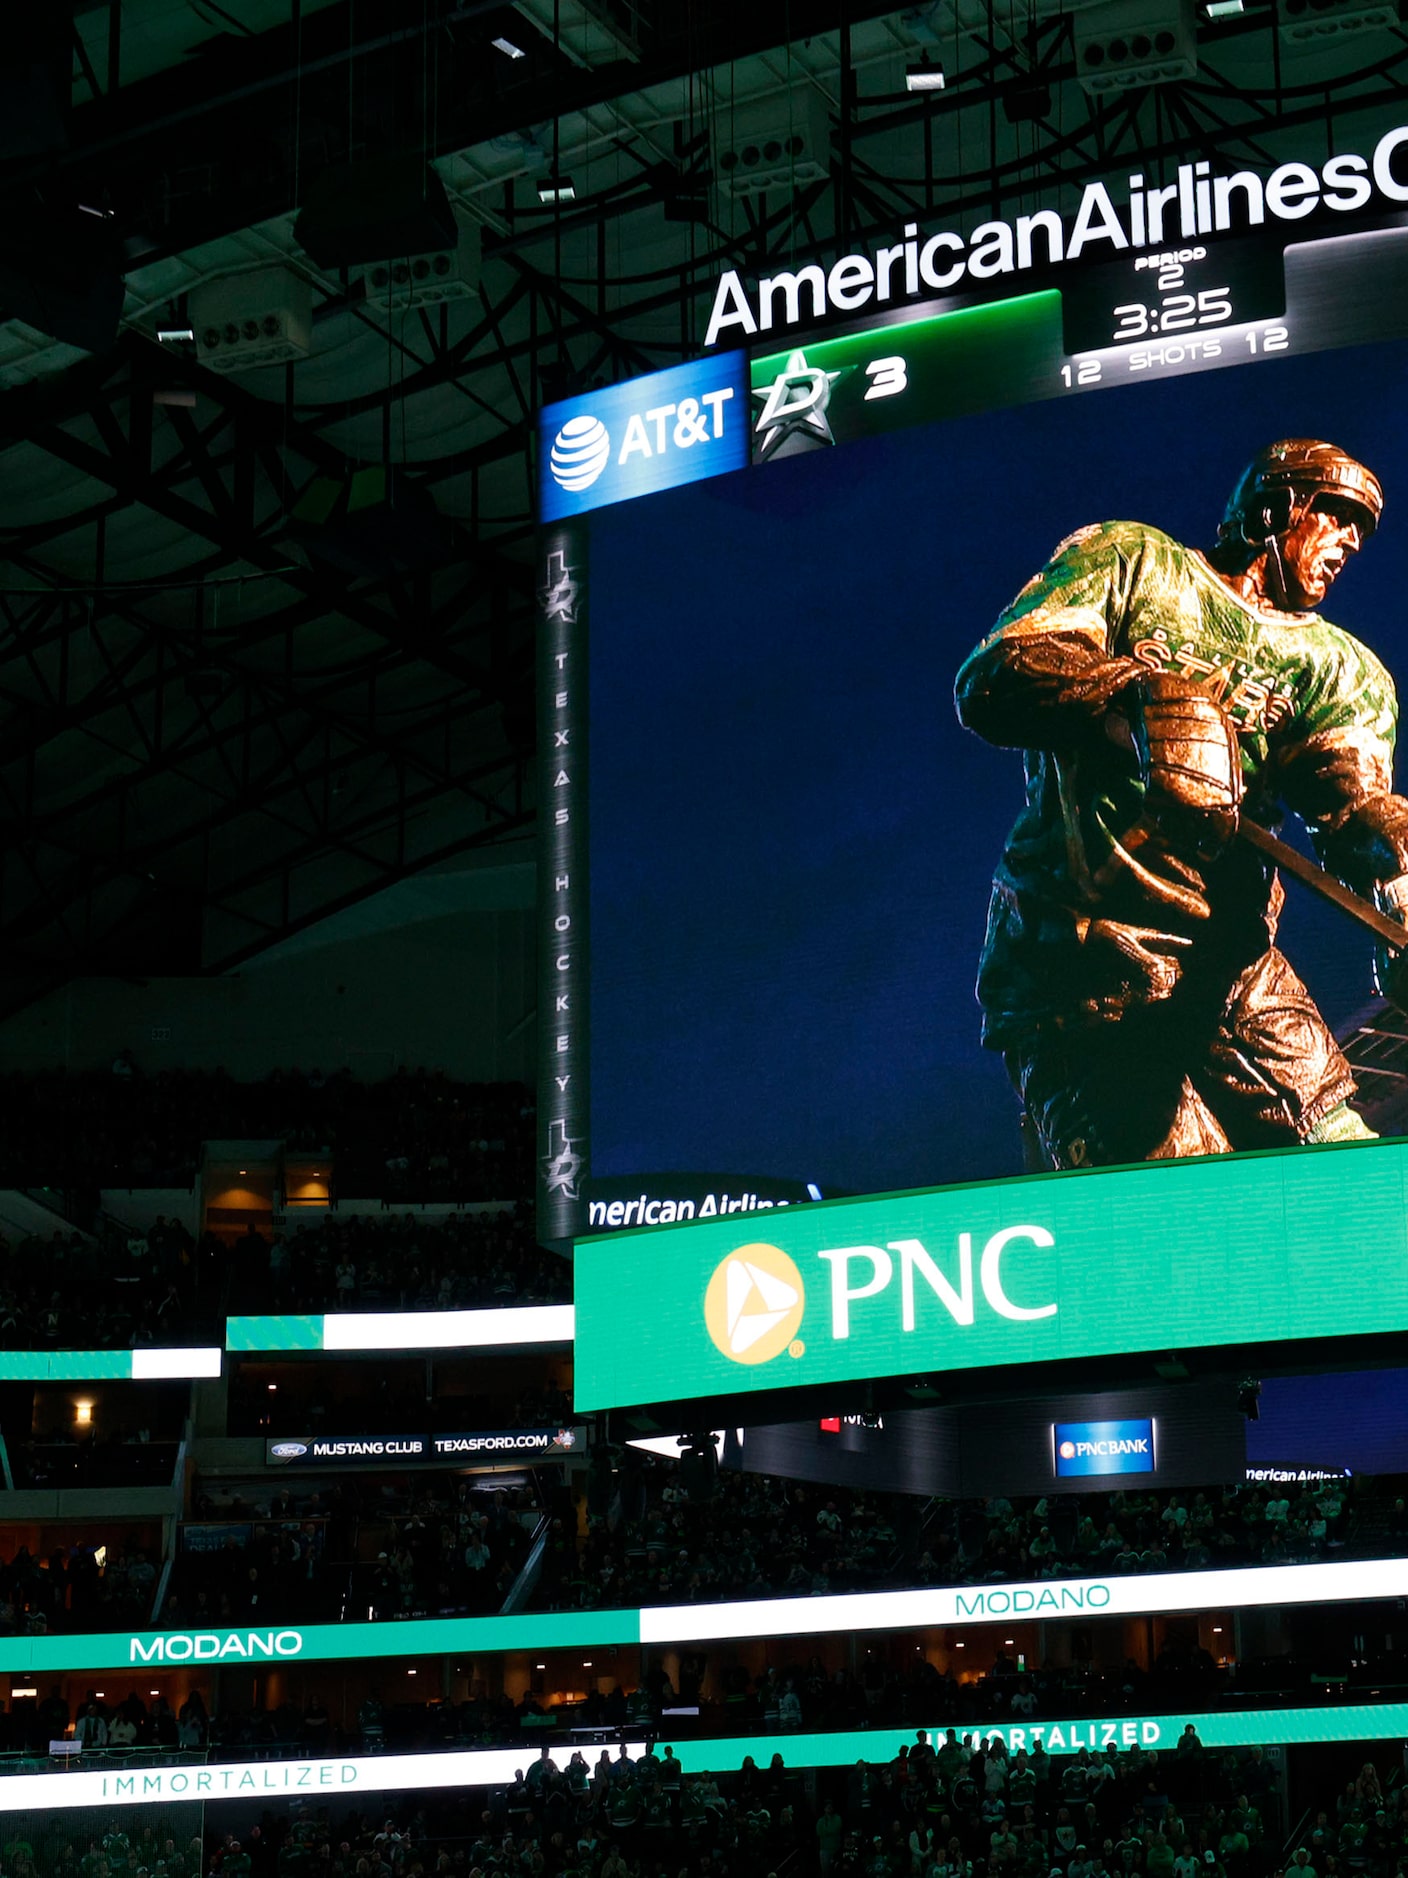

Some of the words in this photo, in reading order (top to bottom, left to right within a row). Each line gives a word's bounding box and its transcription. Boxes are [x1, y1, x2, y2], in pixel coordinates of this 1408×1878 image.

[1134, 246, 1207, 272] PERIOD
[1157, 263, 1186, 290] 2
[1112, 288, 1232, 341] 3:25
[1060, 360, 1102, 388] 12
[1128, 337, 1222, 373] SHOTS
[1245, 326, 1289, 355] 12
[864, 356, 908, 401] 3
[617, 387, 734, 465] AT&T
[817, 1225, 1058, 1340] PNC
[313, 1441, 383, 1456] MUSTANG
[385, 1441, 423, 1454] CLUB
[434, 1434, 548, 1453] TEXASFORD.COM
[1076, 1441, 1108, 1457] PNC
[1108, 1438, 1148, 1454] BANK
[955, 1584, 1111, 1616] MODANO
[129, 1630, 303, 1663] MODANO
[102, 1763, 359, 1798] IMMORTALIZED
